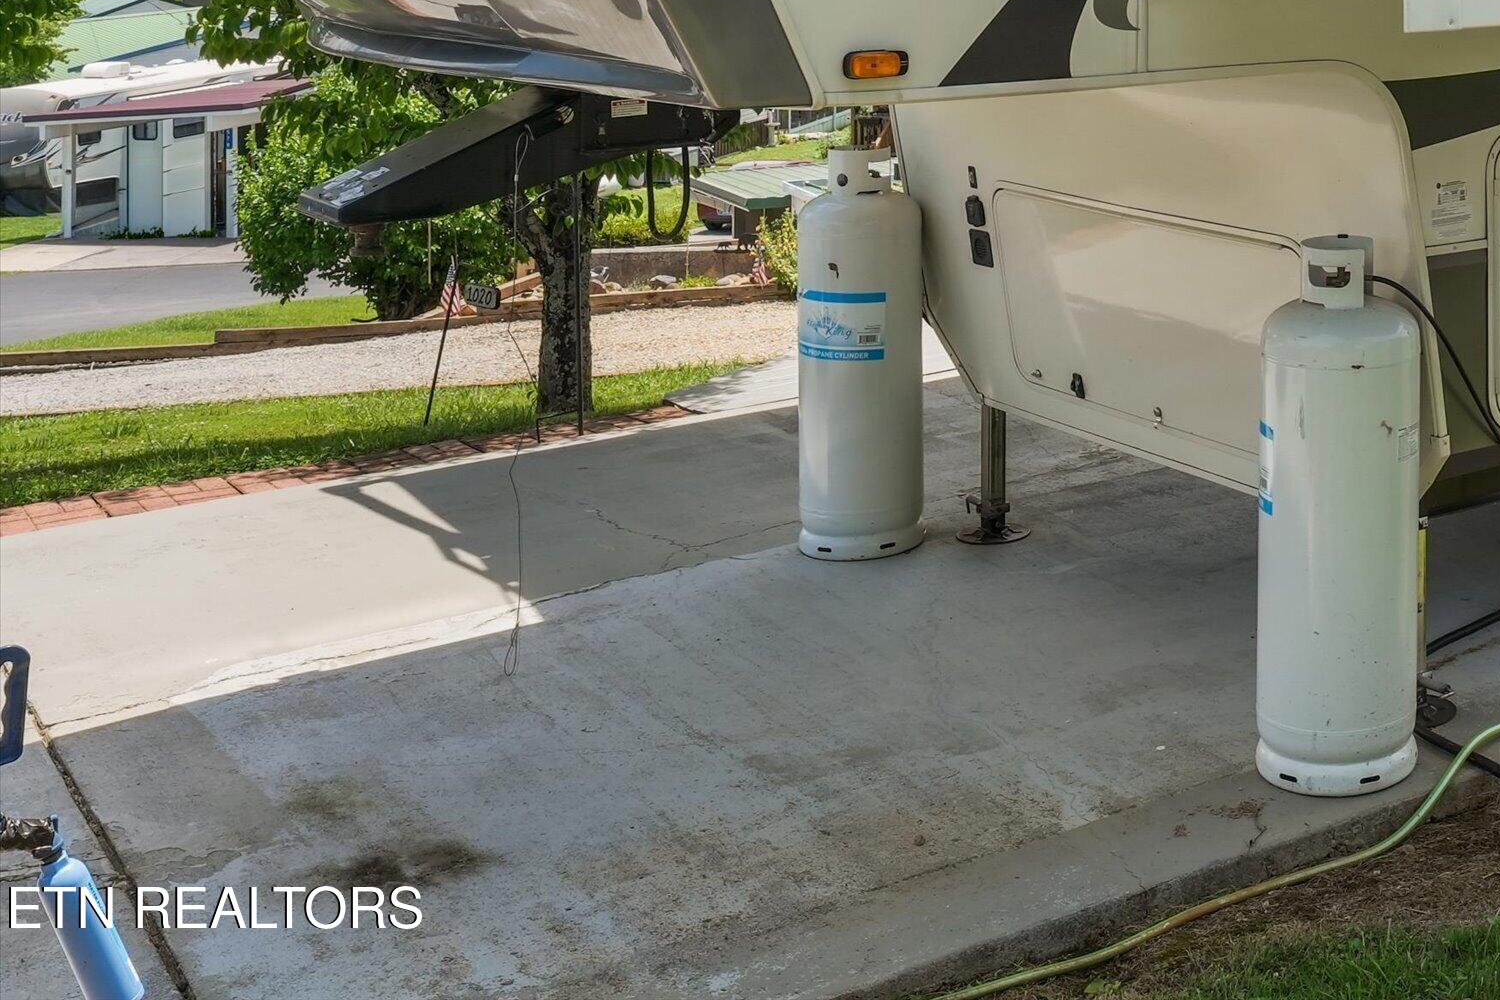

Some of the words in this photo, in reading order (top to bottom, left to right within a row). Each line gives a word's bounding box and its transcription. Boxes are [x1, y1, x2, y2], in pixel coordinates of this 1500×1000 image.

[467, 286, 493, 305] 1020
[808, 348, 833, 359] PROPANE
[834, 351, 869, 359] CYLINDER
